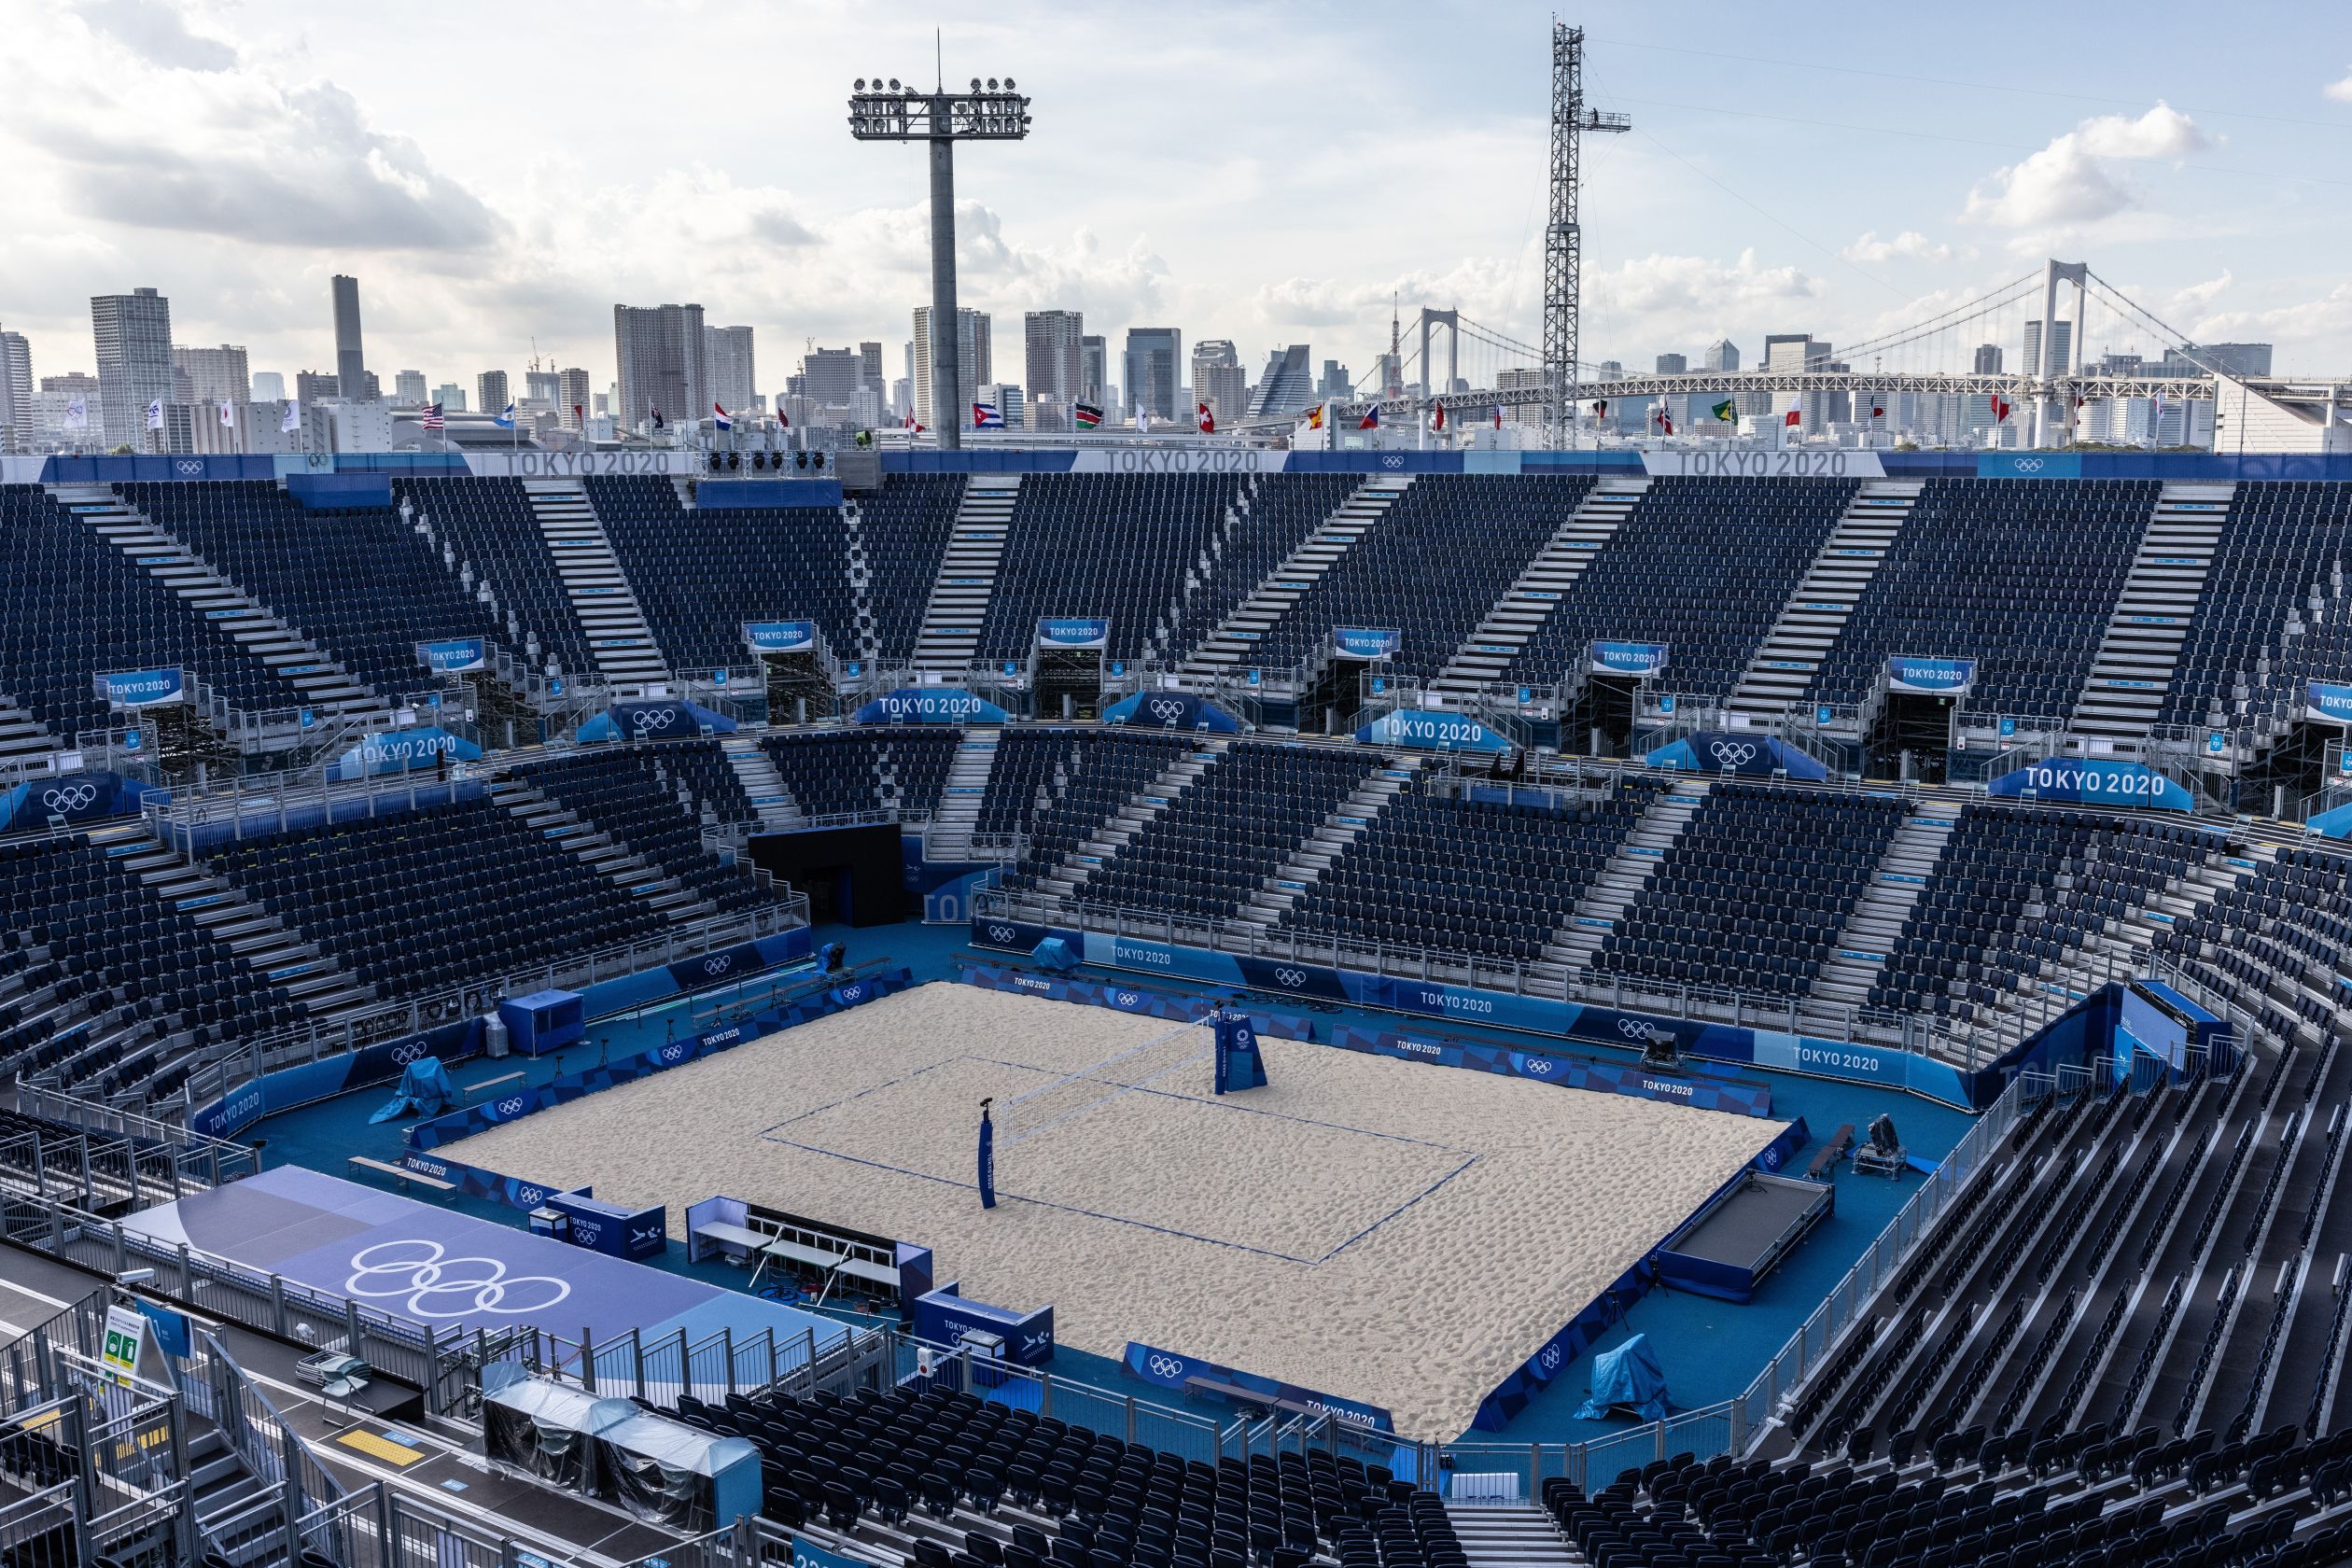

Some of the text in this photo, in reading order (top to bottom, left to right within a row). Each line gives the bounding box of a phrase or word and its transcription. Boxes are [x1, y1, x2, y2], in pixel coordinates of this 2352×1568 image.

[503, 453, 669, 477] TOKYO 2020
[1105, 450, 1258, 473] TOKYO 2020
[1676, 451, 1846, 476] TOKYO 2020
[754, 630, 803, 640] TOKYO 2020
[1050, 627, 1099, 636] TOKYO 2020
[1345, 637, 1390, 648] TOKYO 2020
[455, 649, 473, 659] 2020
[1603, 651, 1656, 663] TOKYO 2020
[1903, 667, 1962, 680] TOKYO 2020
[109, 679, 171, 695] TOKYO 2020
[879, 698, 981, 714] TOKYO 2020
[1381, 718, 1481, 742] TOKYO 2020
[352, 742, 412, 766] TOKYO
[2025, 766, 2164, 795] TOKYO 2020
[1111, 945, 1170, 965] TOKYO 2020
[1015, 977, 1050, 990] TOKYO 2020
[1421, 992, 1491, 1013] TOKYO 2020
[703, 1028, 740, 1046] TOKYO 2020
[1397, 1041, 1441, 1055] TOKYO 2020
[1792, 1046, 1878, 1071] TOKYO 2020
[1643, 1080, 1693, 1096] TOKYO 2020
[209, 1091, 259, 1132] TOKYO 2020
[407, 1157, 447, 1176] TOKYO 2020
[569, 1217, 587, 1228] TOKYO
[945, 1320, 968, 1333] TOKYO
